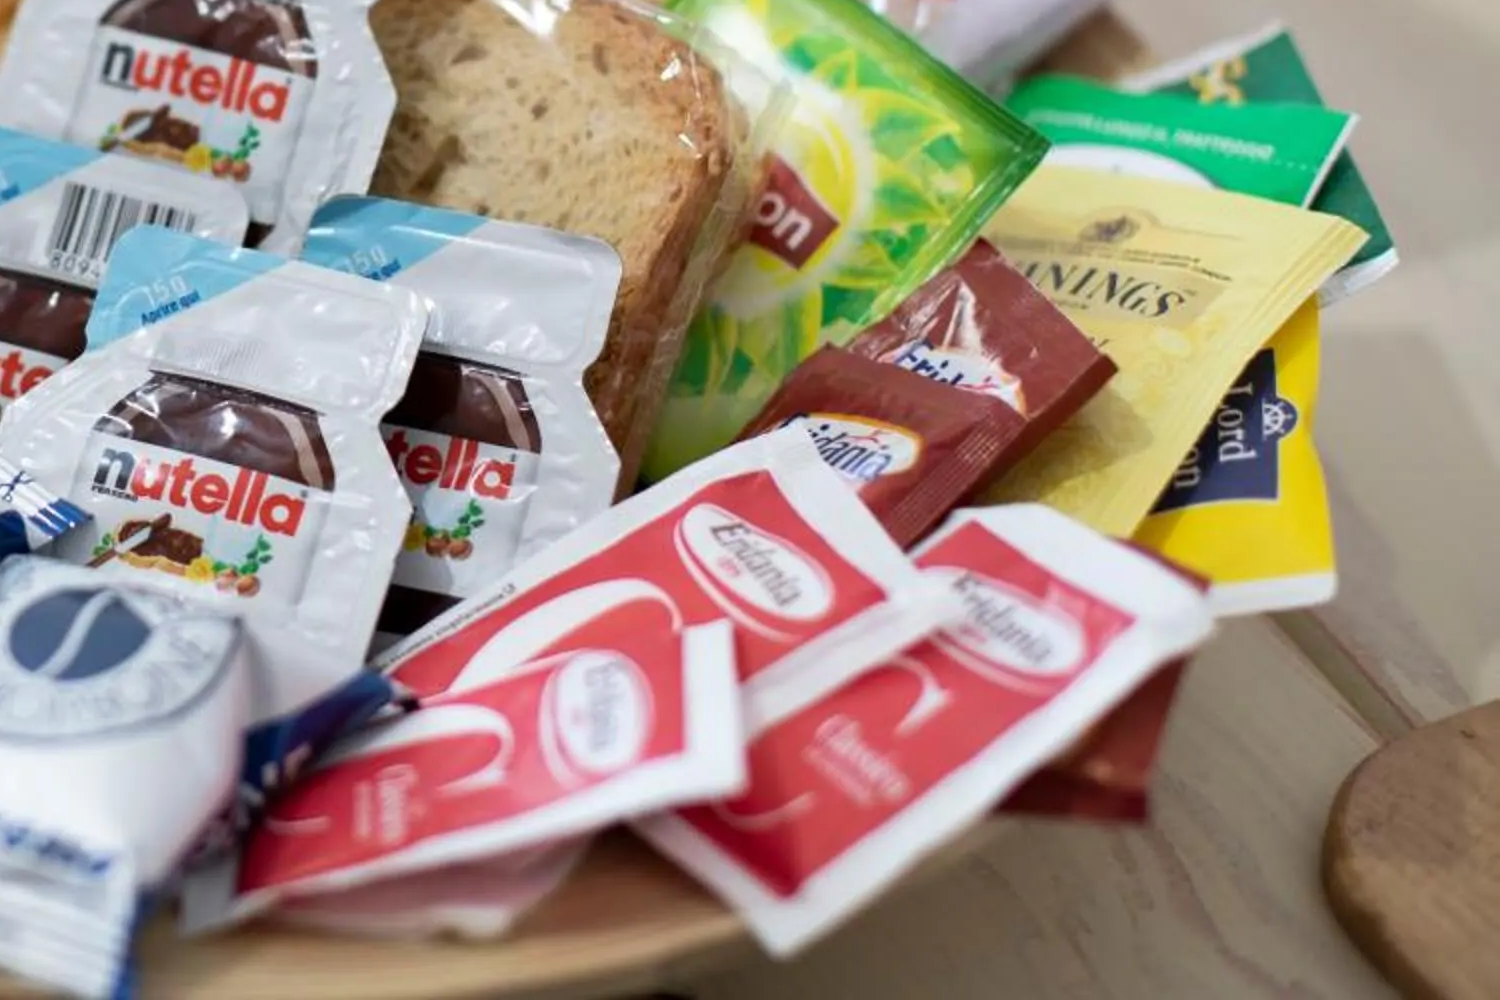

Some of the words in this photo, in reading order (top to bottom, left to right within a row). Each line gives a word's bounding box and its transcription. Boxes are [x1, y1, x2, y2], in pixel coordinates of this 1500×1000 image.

[102, 41, 290, 122] nutella
[92, 444, 307, 537] nutella
[386, 425, 517, 499] tella
